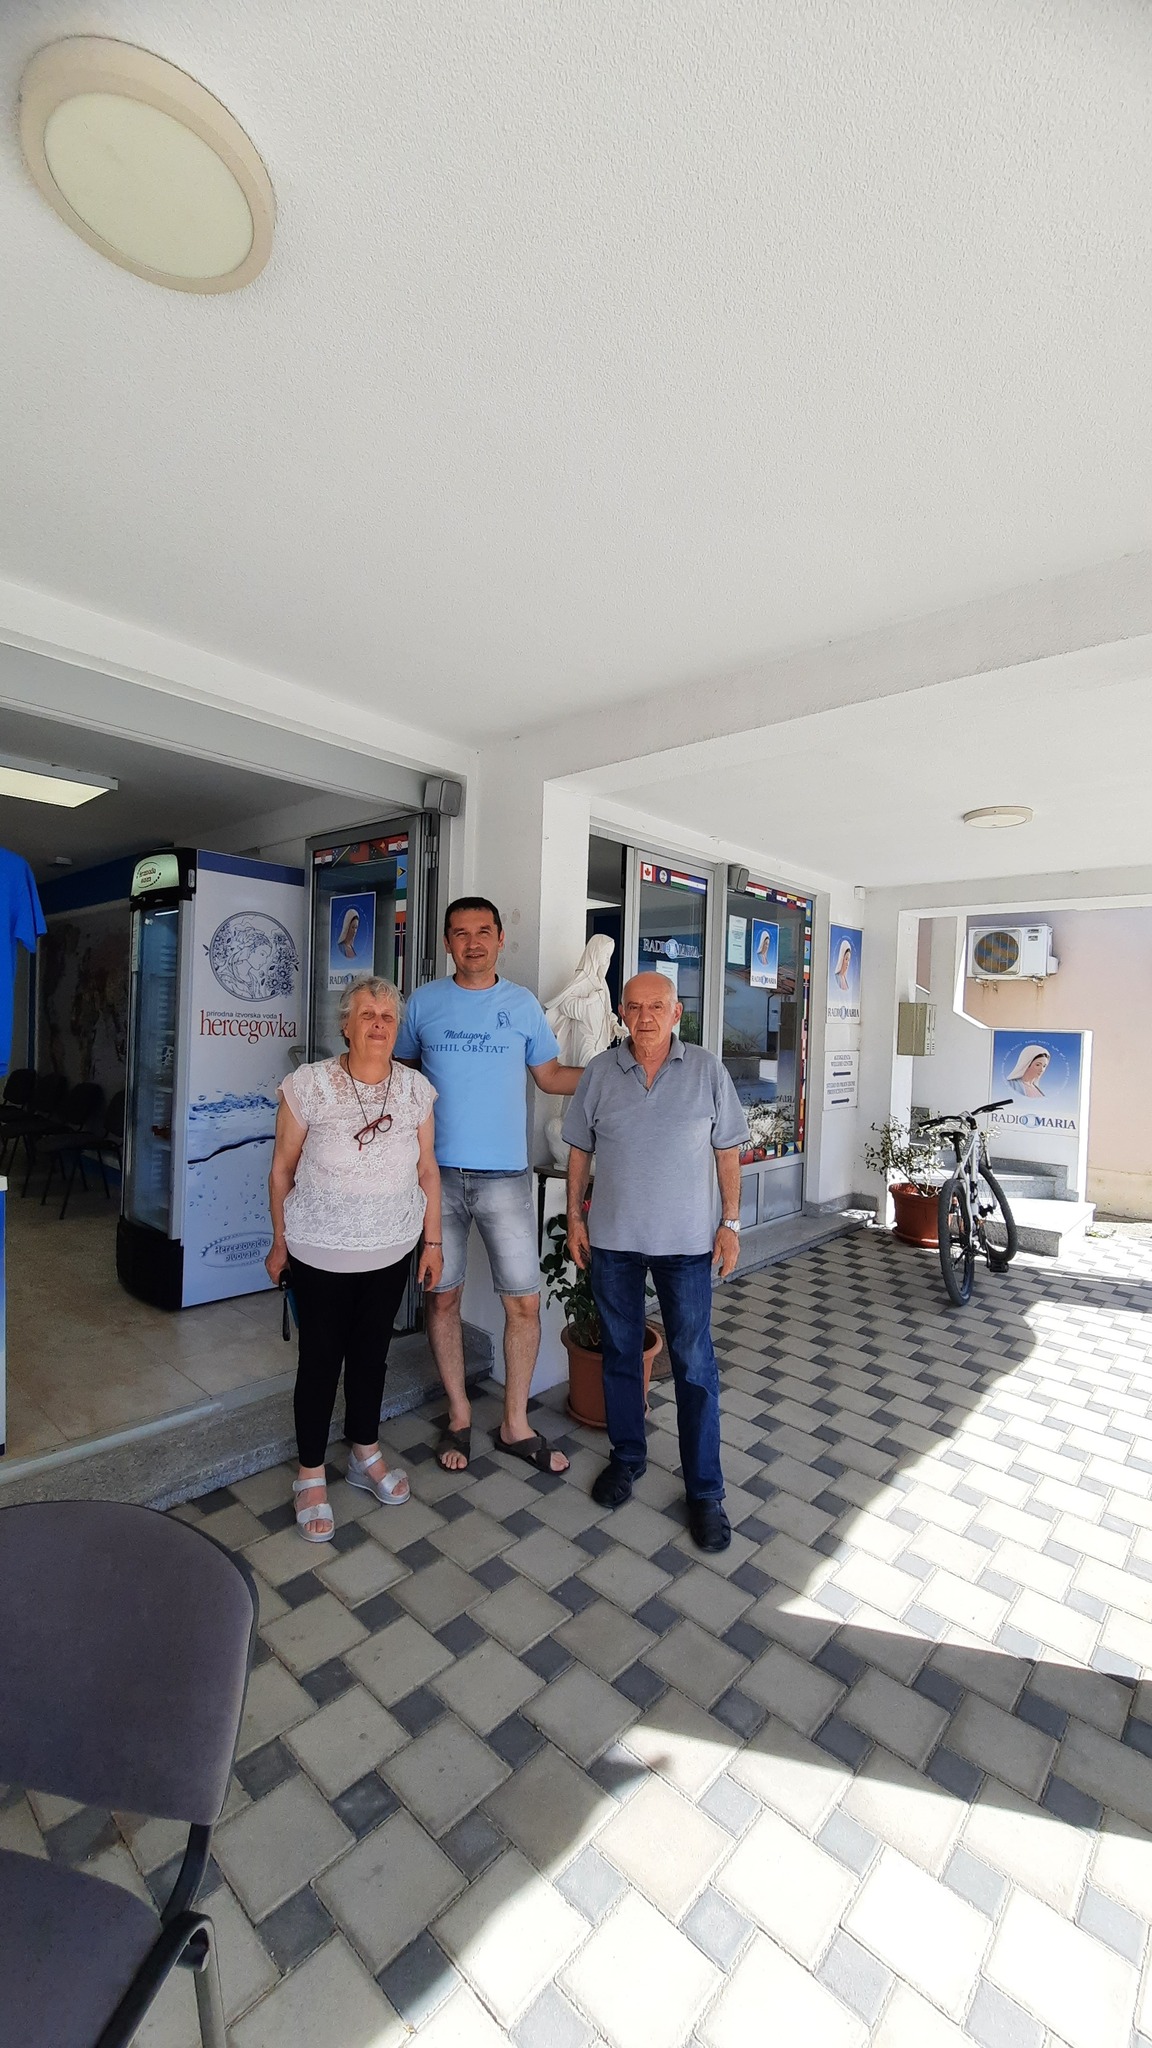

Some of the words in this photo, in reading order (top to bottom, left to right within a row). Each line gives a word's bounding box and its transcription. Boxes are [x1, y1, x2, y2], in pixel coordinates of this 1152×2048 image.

[330, 976, 349, 985] RADIO
[200, 1009, 298, 1045] hercegovka
[991, 1112, 1029, 1126] RADIO
[1034, 1116, 1077, 1130] MARIA
